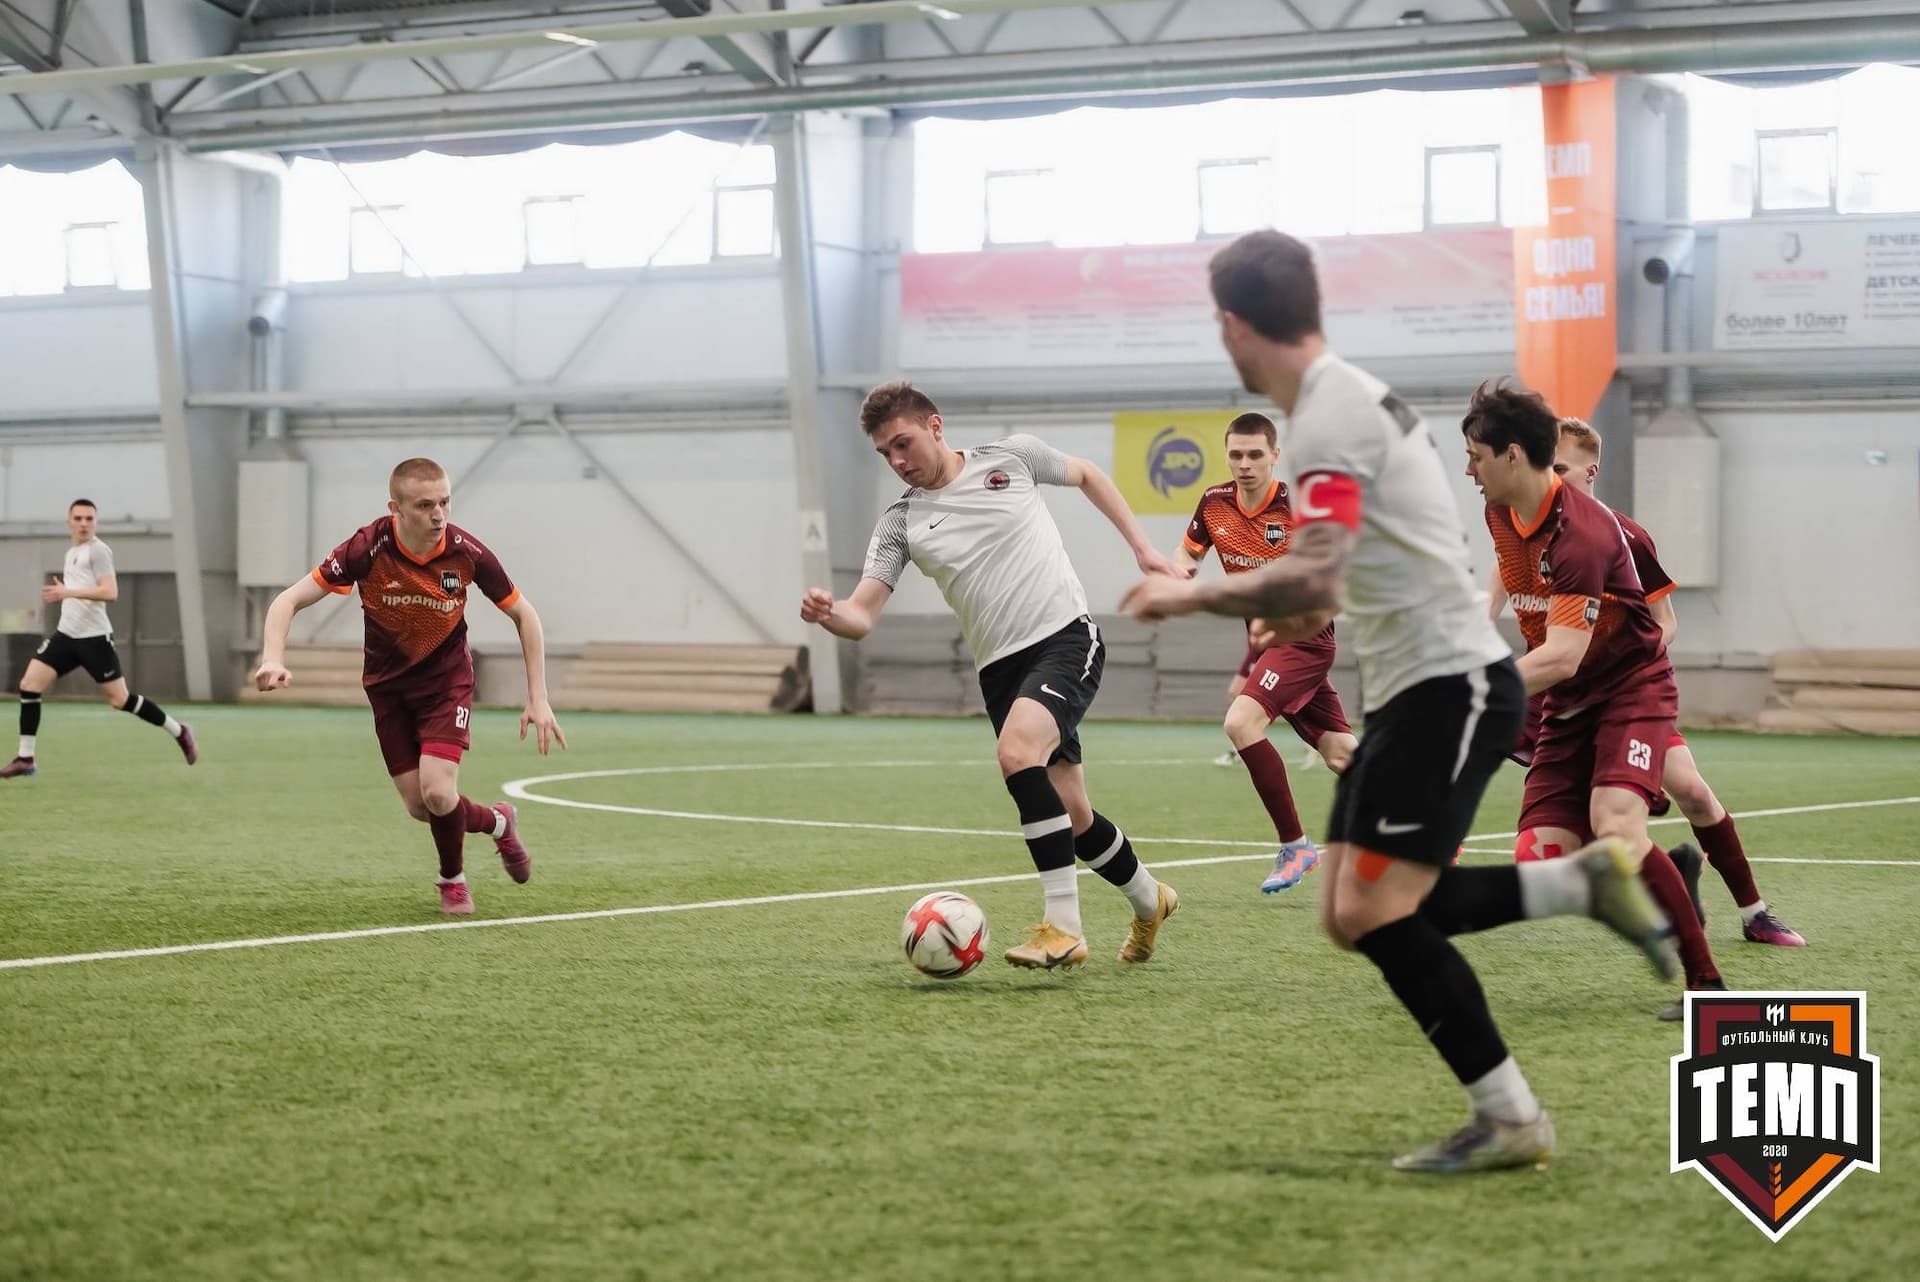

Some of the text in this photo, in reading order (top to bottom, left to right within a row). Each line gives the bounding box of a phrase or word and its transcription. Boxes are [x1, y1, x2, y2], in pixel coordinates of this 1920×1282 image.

[1545, 142, 1592, 179] ЕМП
[1533, 236, 1596, 278] ОДНА
[1525, 282, 1606, 323] СЕМЬЯ!
[1259, 669, 1281, 691] 19
[455, 706, 470, 730] 27
[1627, 738, 1652, 772] 23
